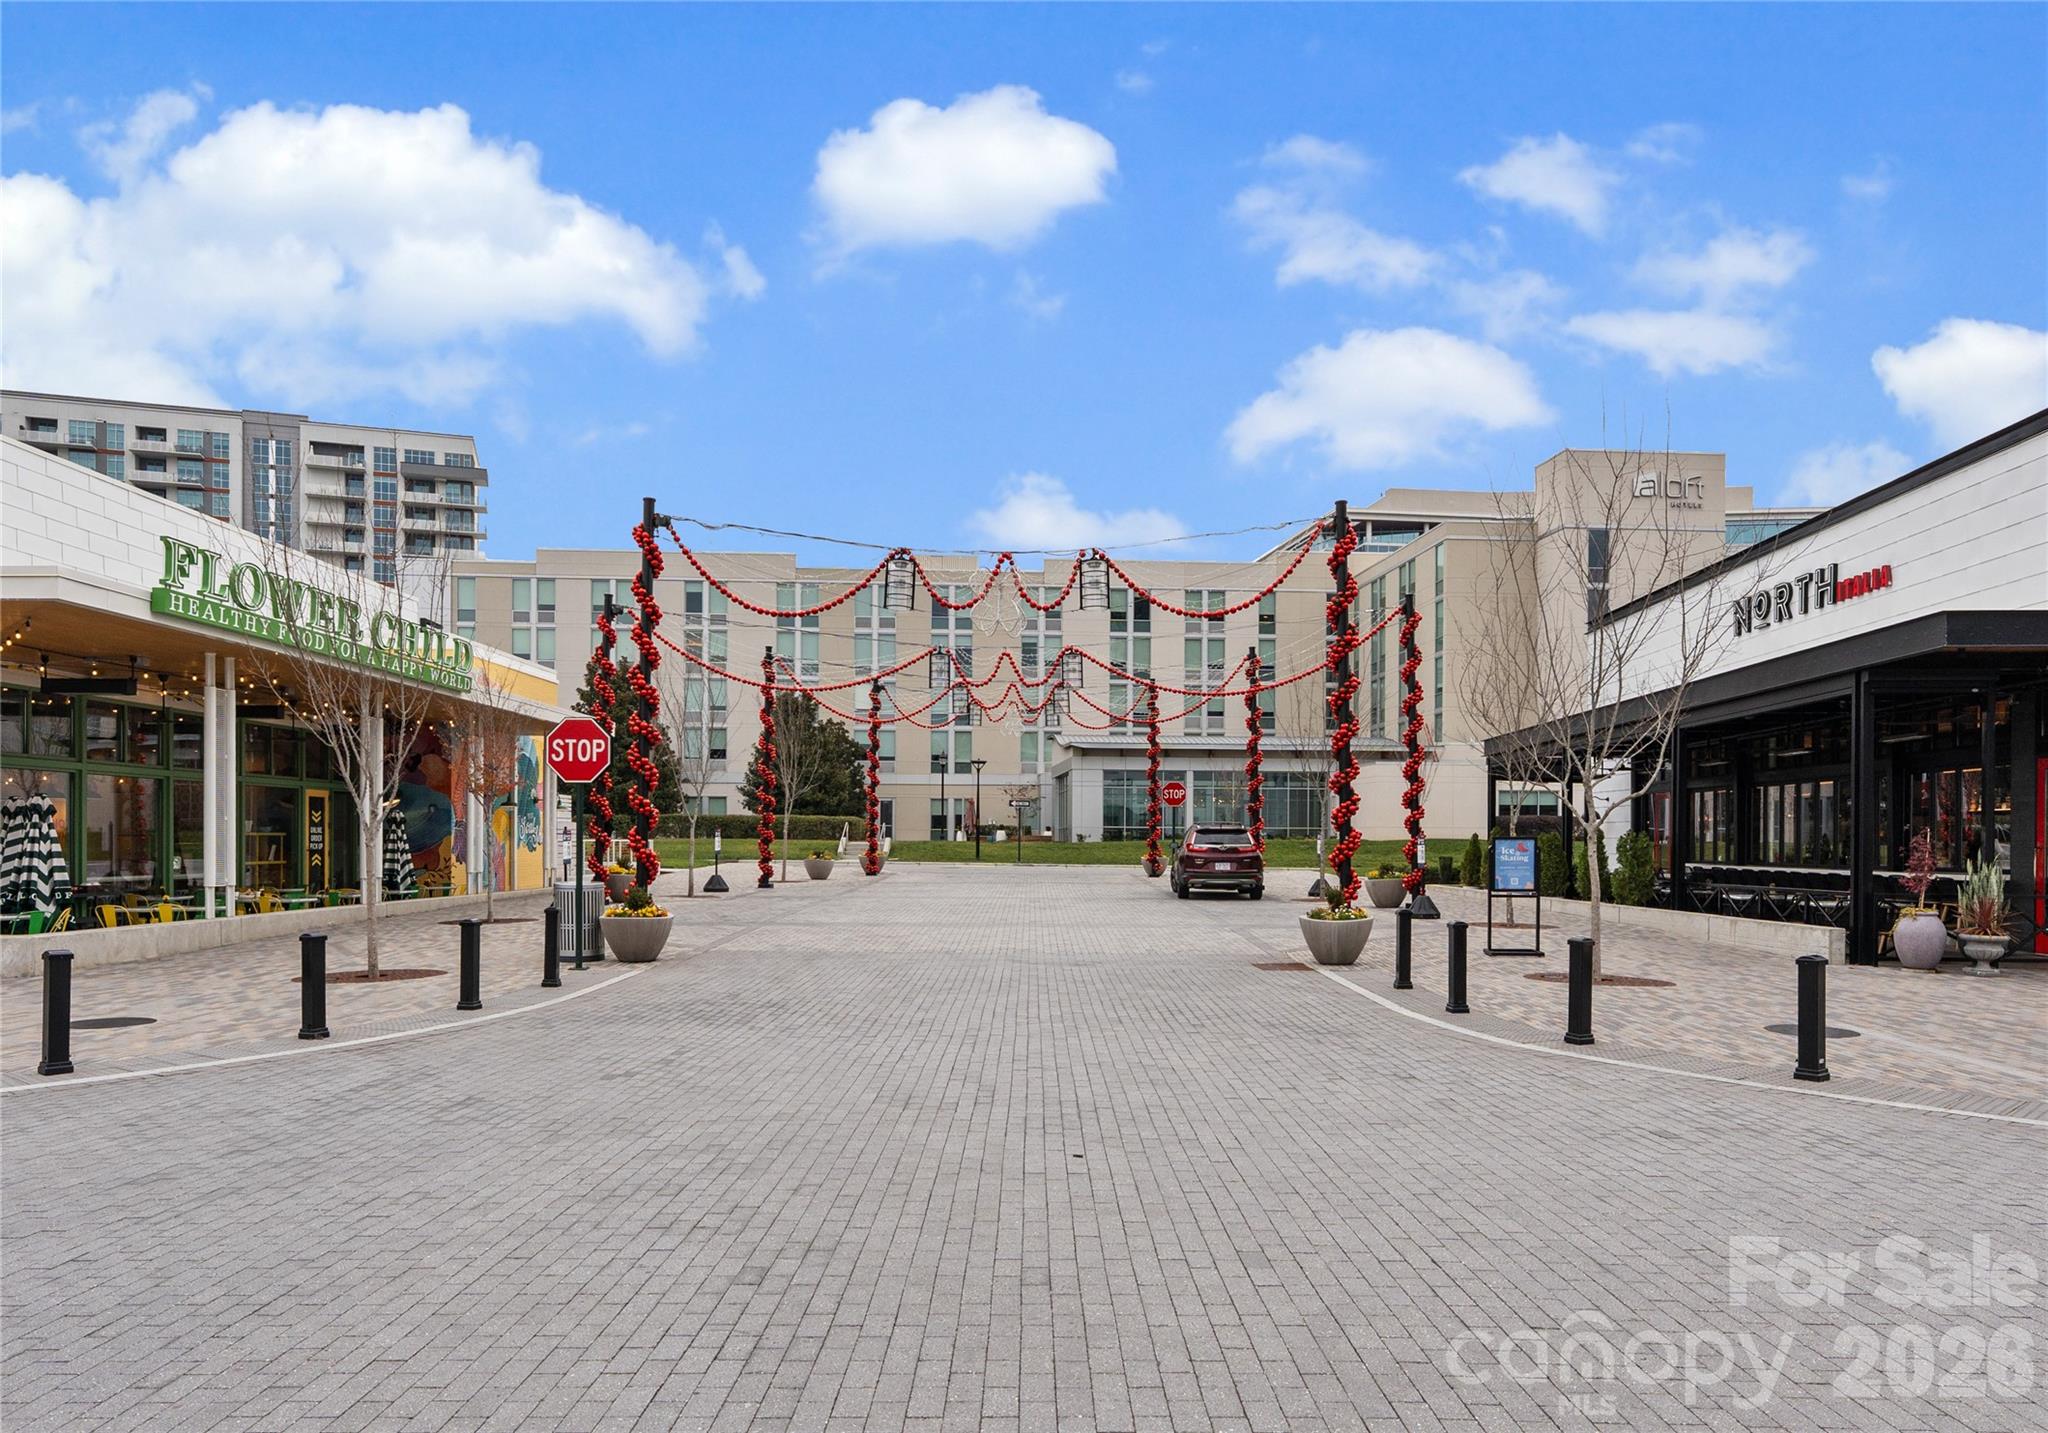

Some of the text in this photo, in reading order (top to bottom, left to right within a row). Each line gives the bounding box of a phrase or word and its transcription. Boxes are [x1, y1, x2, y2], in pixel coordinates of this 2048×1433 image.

[1633, 473, 1704, 499] aloft
[159, 535, 474, 673] FLOWER CHILD
[1733, 563, 1892, 637] NORTH ITALIA
[169, 592, 271, 637] HEALTHY
[430, 668, 472, 691] WORLD
[551, 738, 606, 762] STOP
[1163, 789, 1185, 799] STOP
[1501, 846, 1515, 855] Ice
